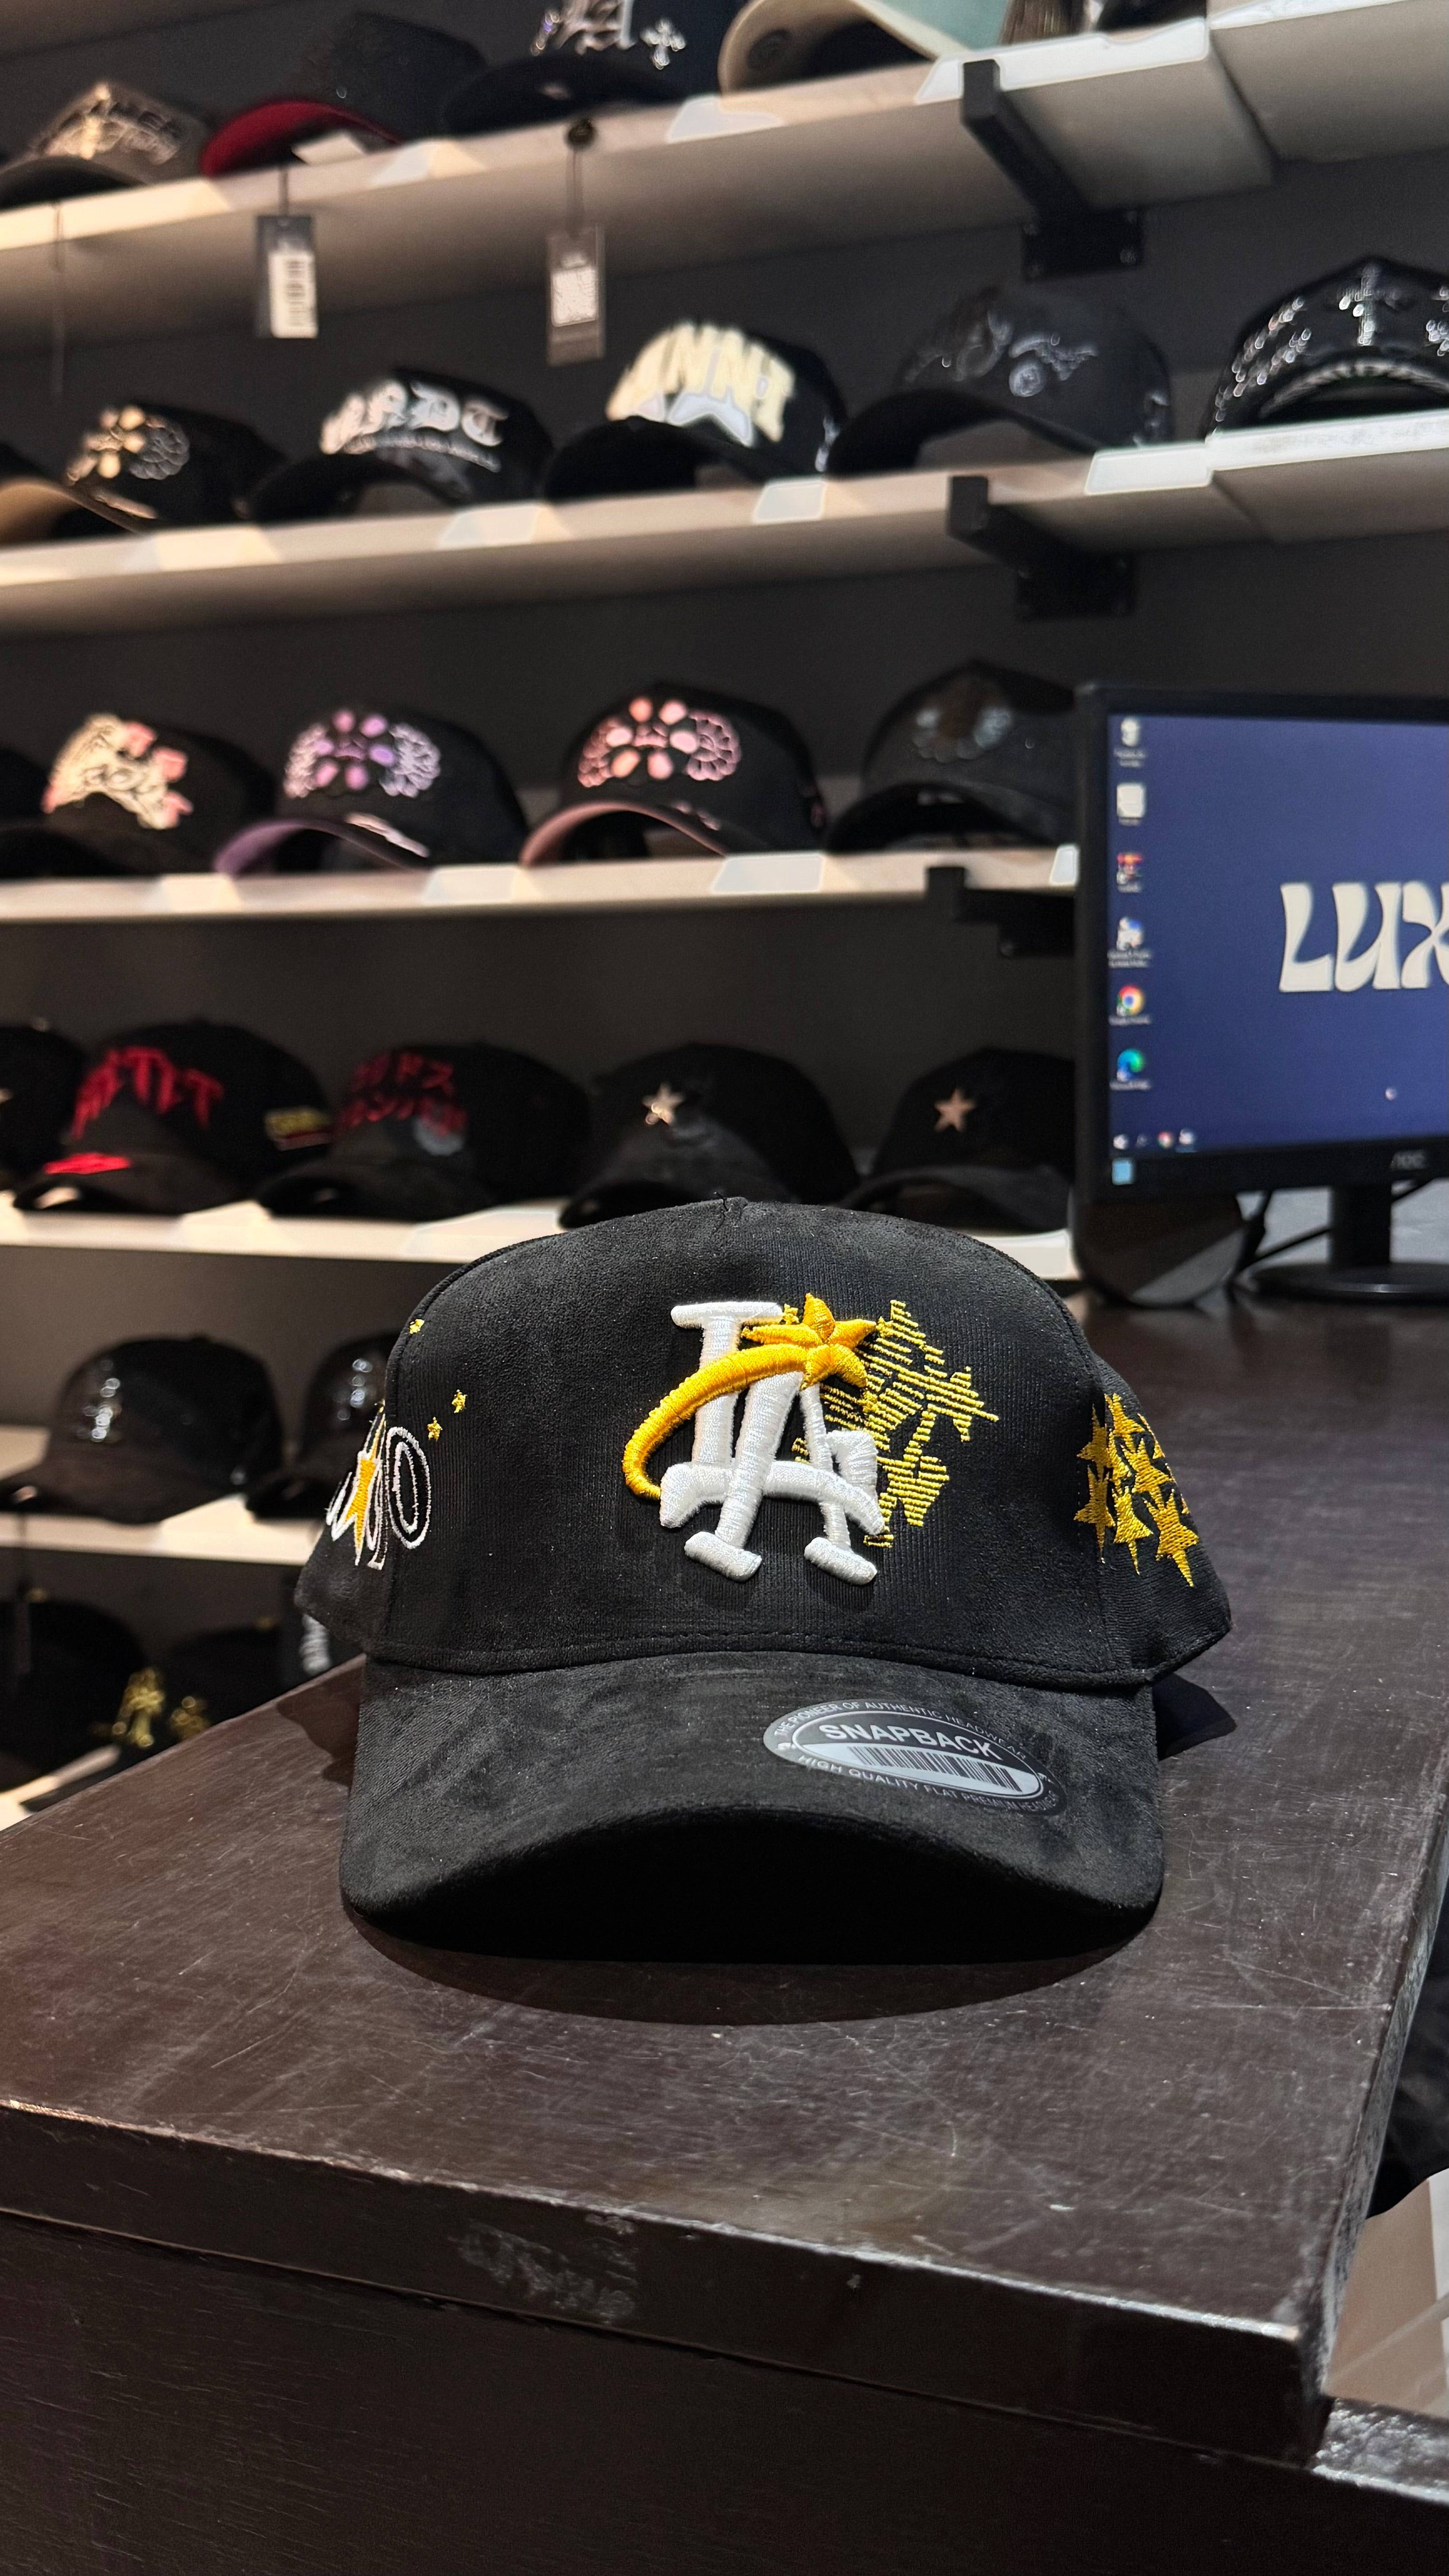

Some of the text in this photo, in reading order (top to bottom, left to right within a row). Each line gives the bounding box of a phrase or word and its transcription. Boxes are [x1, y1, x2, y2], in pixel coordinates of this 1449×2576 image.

[773, 1701, 1026, 1760] THE PIONEER OF AUTHENTIC HEADWEAR
[819, 1724, 1003, 1761] SNAPBACK
[797, 1755, 842, 1774] HIGH
[848, 1768, 919, 1790] QUALITY
[923, 1785, 959, 1799] FLAT
